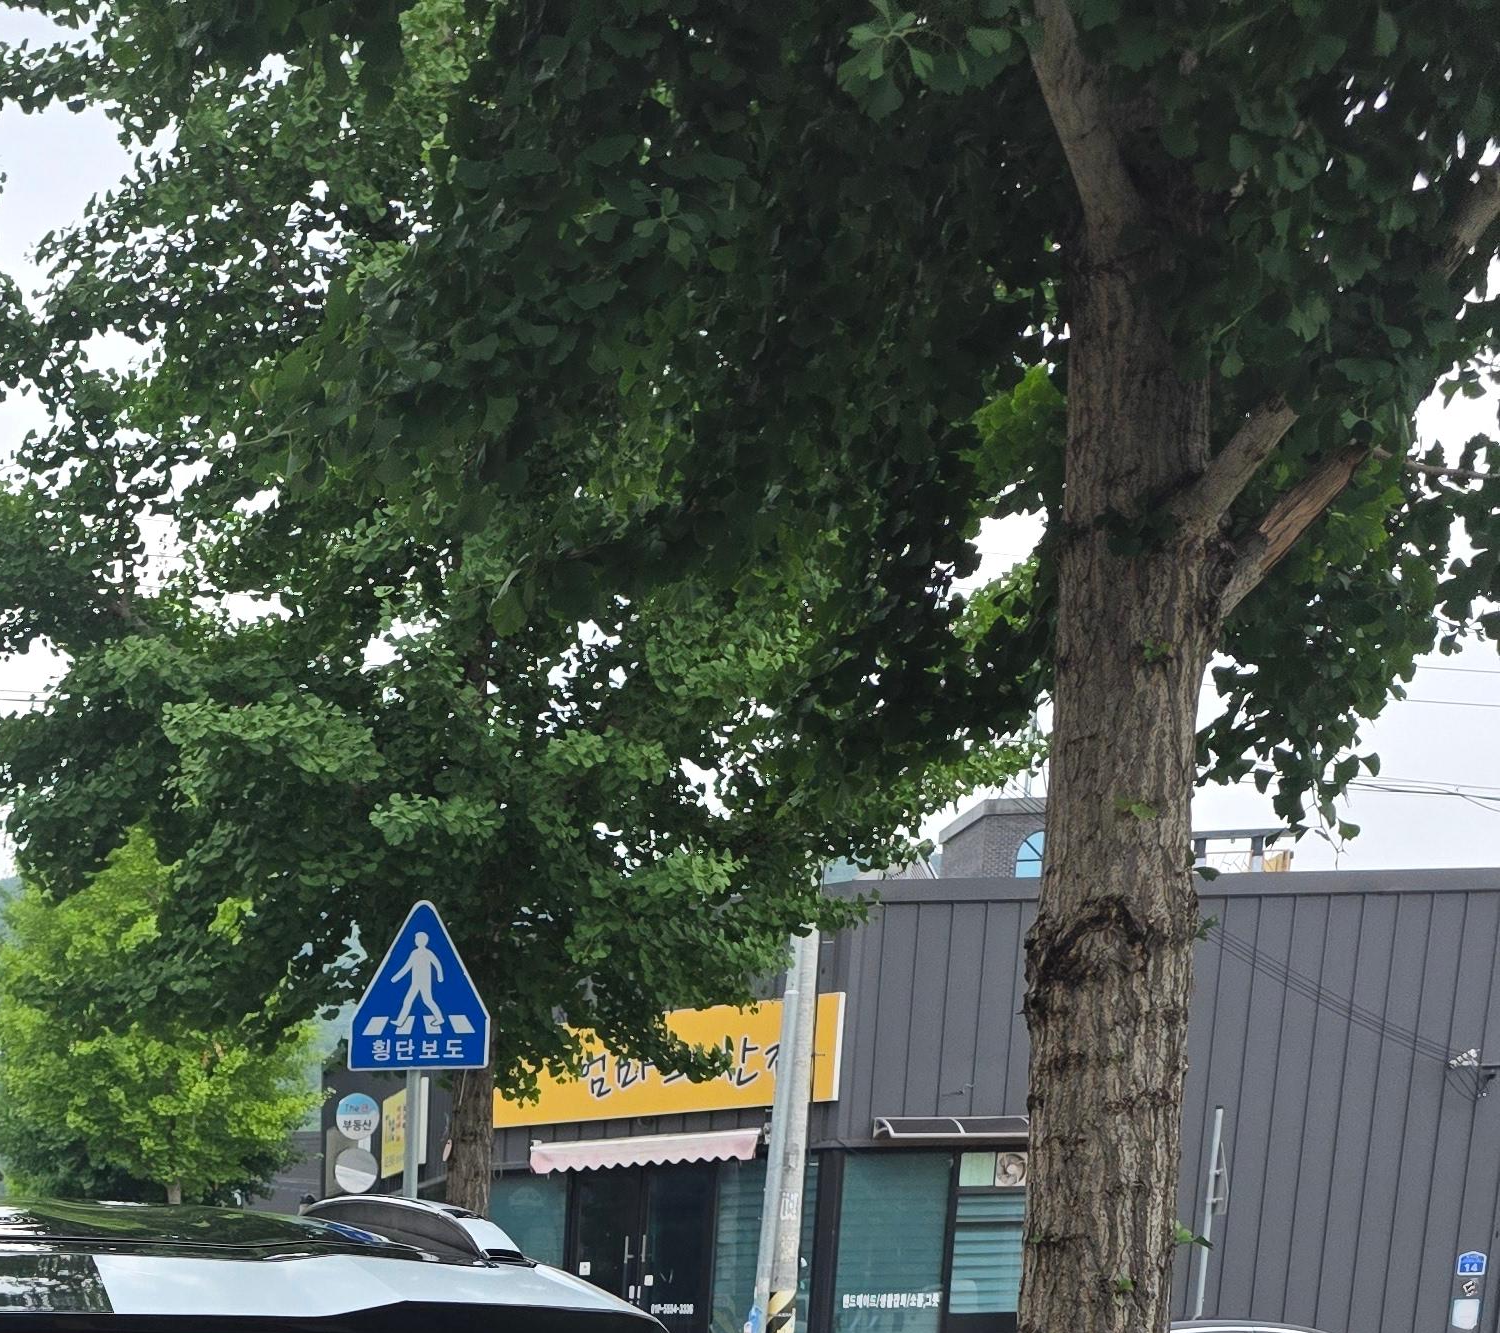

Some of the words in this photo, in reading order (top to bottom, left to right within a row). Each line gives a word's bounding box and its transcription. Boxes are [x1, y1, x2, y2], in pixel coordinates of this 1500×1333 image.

[372, 1039, 464, 1061] 횡단보도
[342, 1119, 372, 1132] 부동산
[1464, 1263, 1478, 1272] 14
